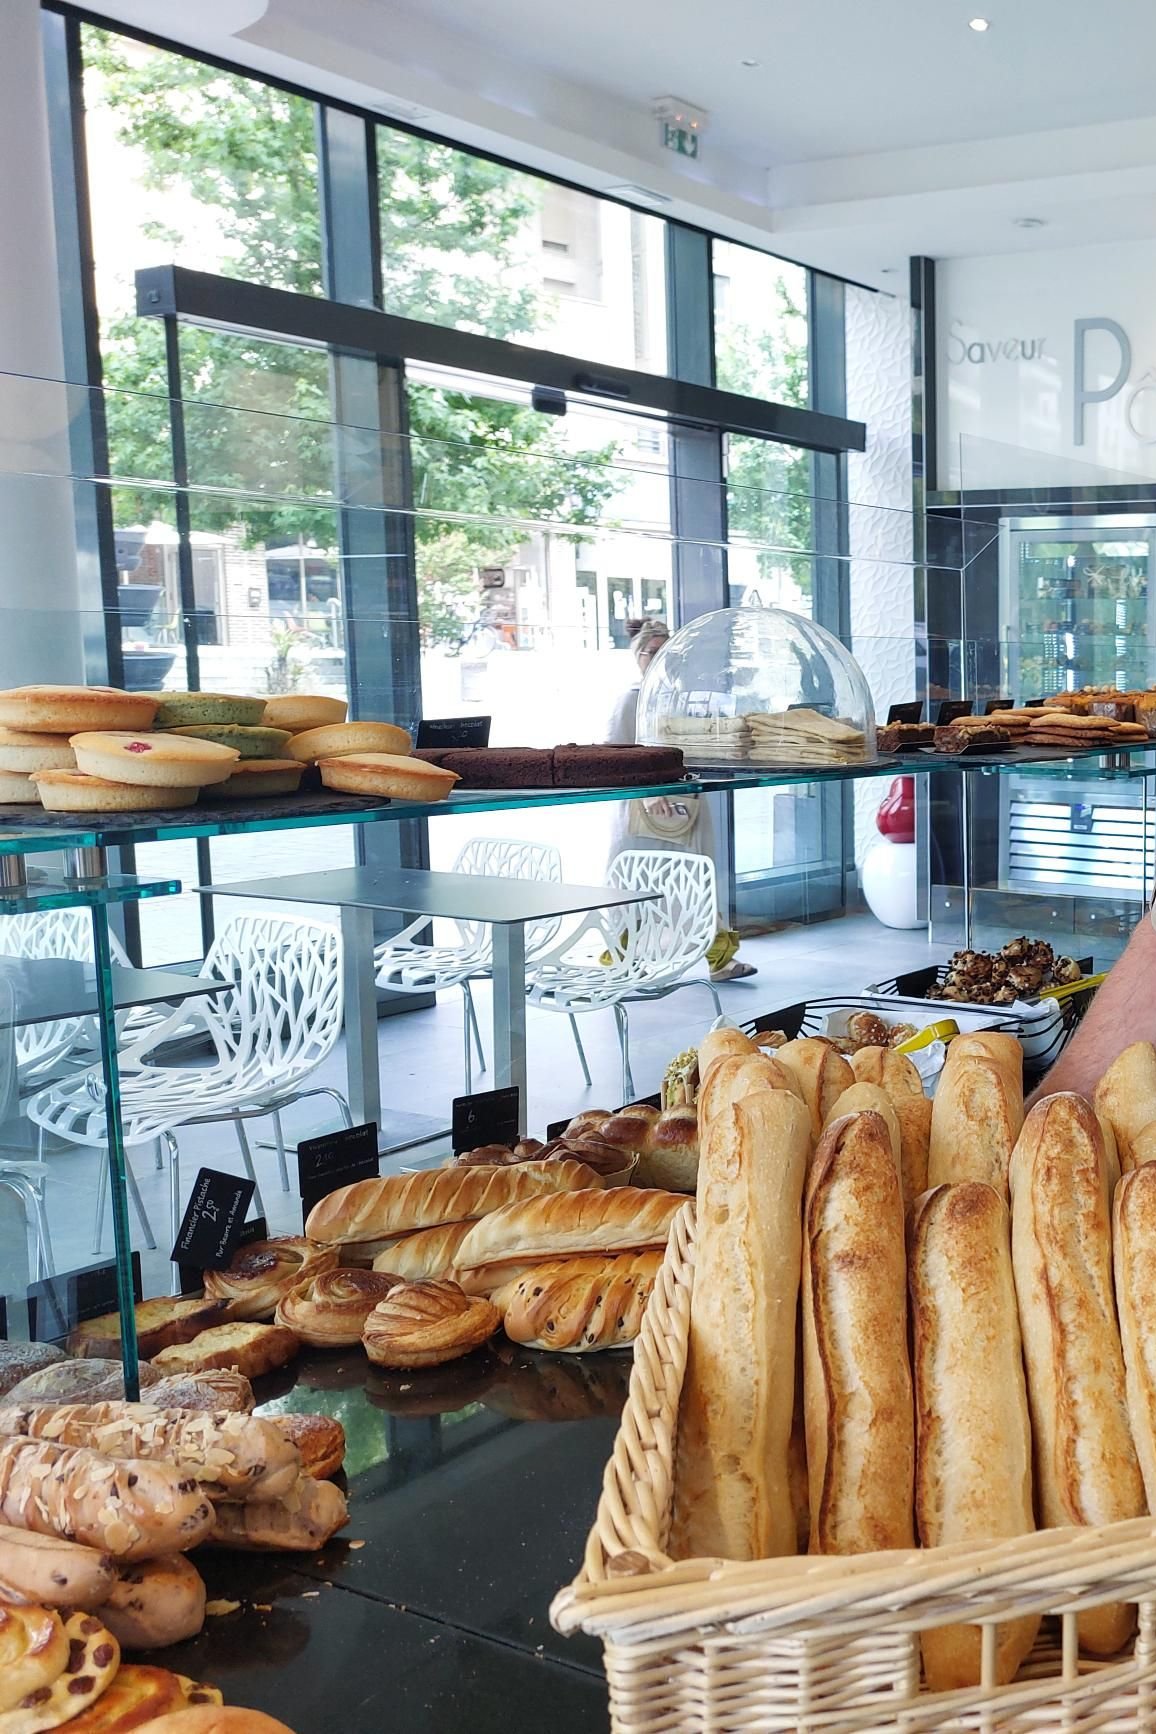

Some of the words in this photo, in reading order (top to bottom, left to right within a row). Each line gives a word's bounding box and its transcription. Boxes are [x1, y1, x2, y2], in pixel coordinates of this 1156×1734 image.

[946, 319, 1047, 365] Saveur
[180, 1210, 200, 1250] Financier
[193, 1178, 211, 1212] Pistache
